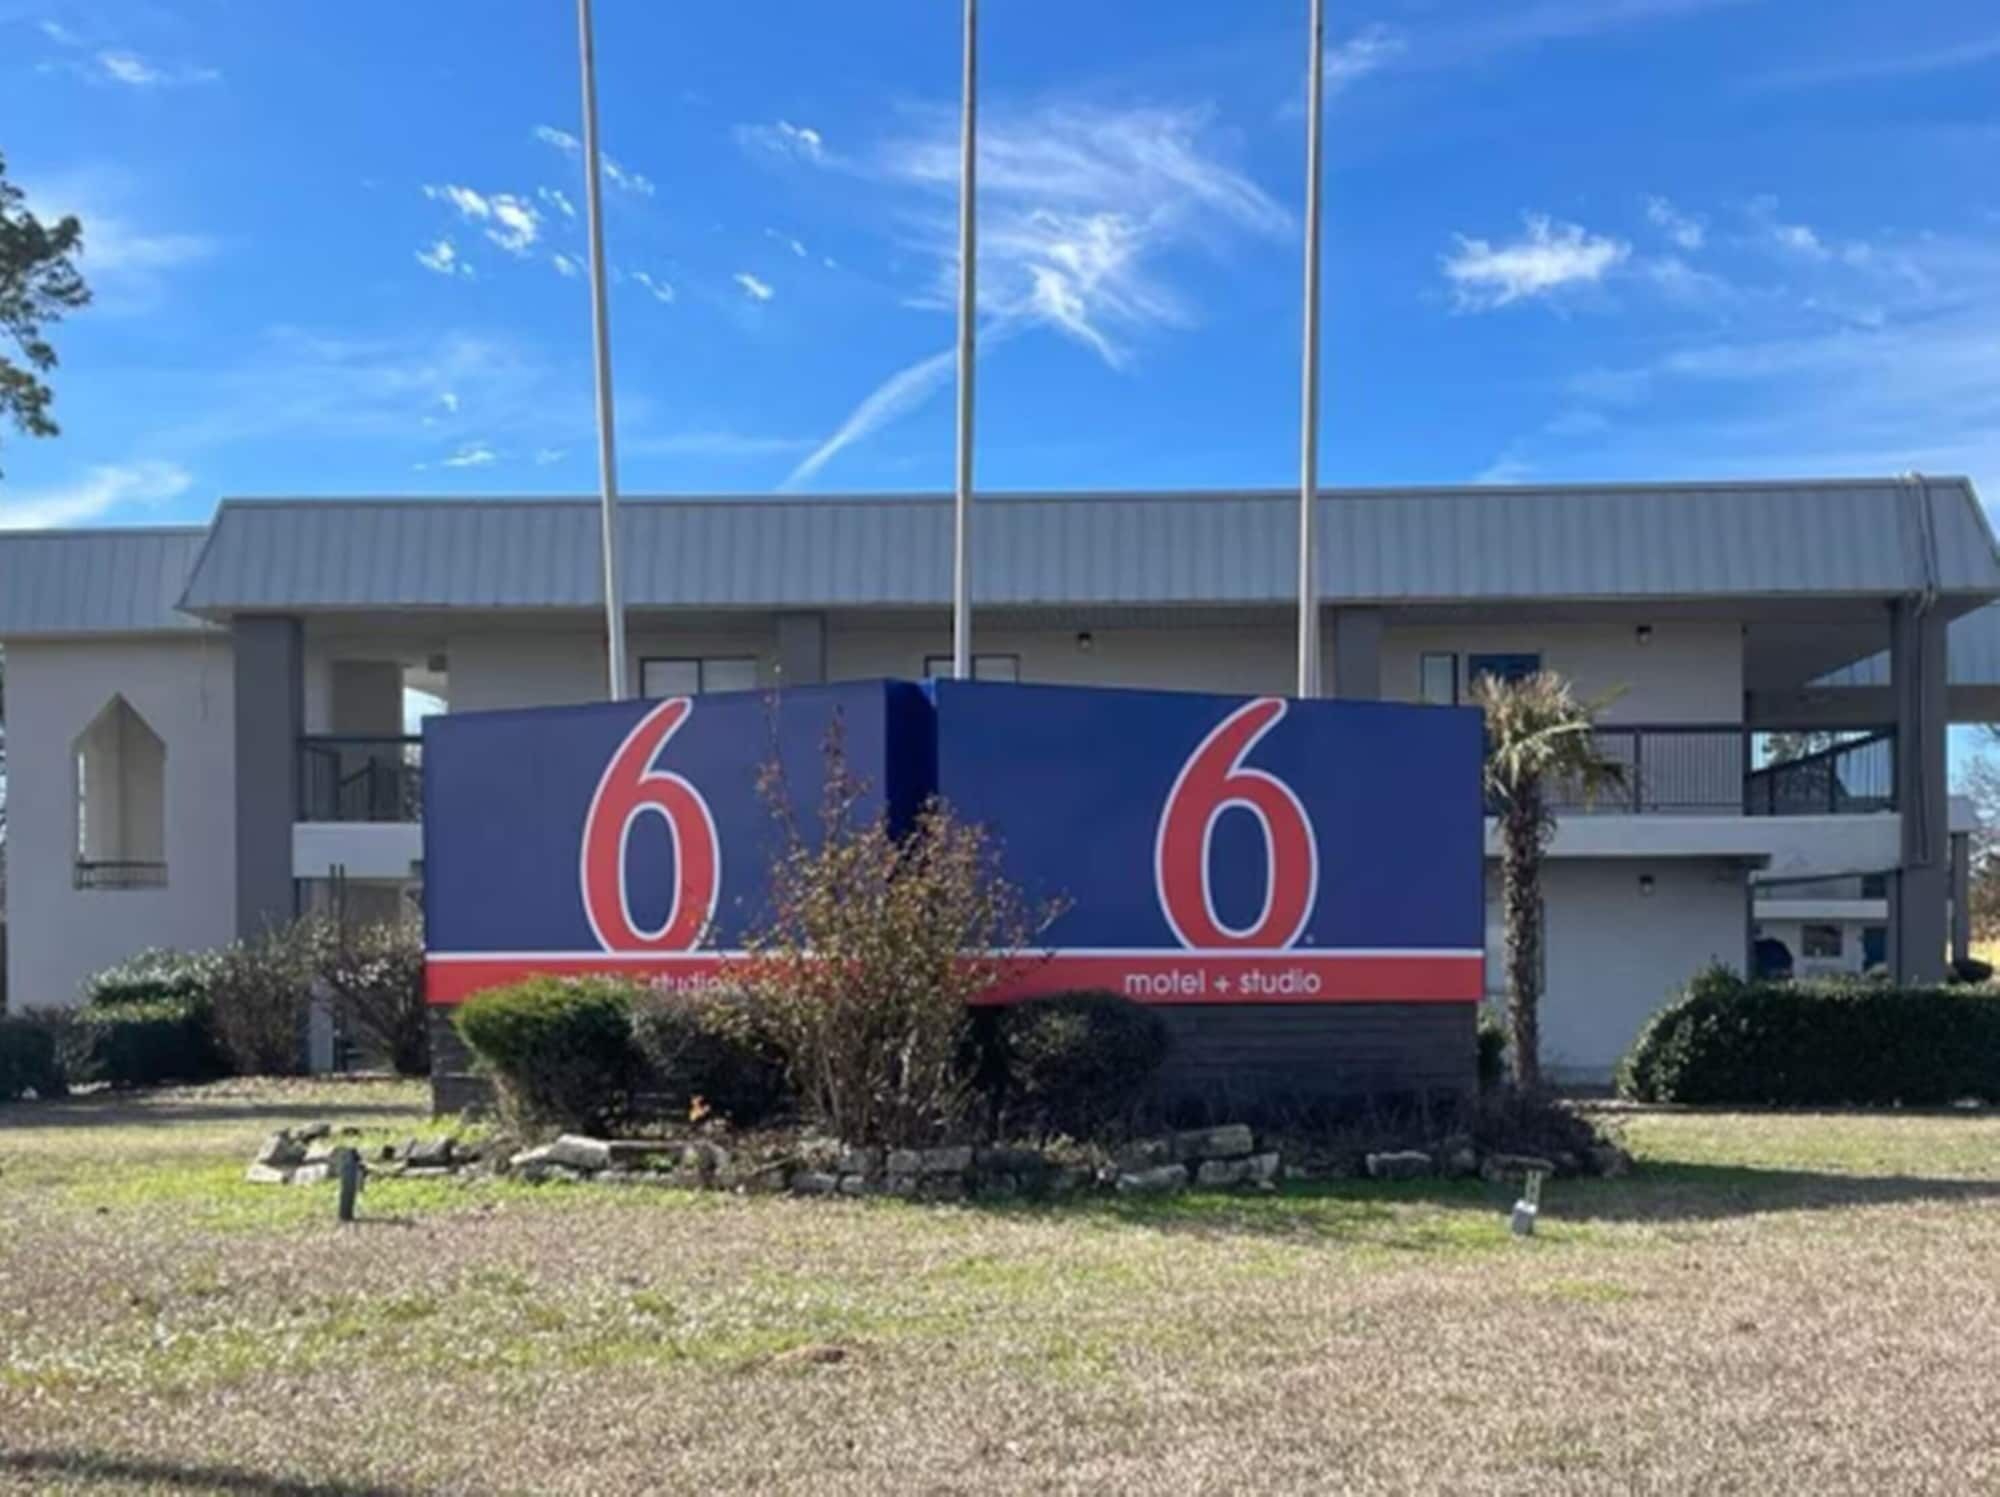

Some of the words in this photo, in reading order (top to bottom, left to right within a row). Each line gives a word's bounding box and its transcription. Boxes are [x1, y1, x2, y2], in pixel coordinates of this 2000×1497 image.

[580, 697, 721, 953] 6
[1154, 698, 1319, 950] 6
[1125, 968, 1205, 995] motel
[1239, 968, 1322, 994] studio
